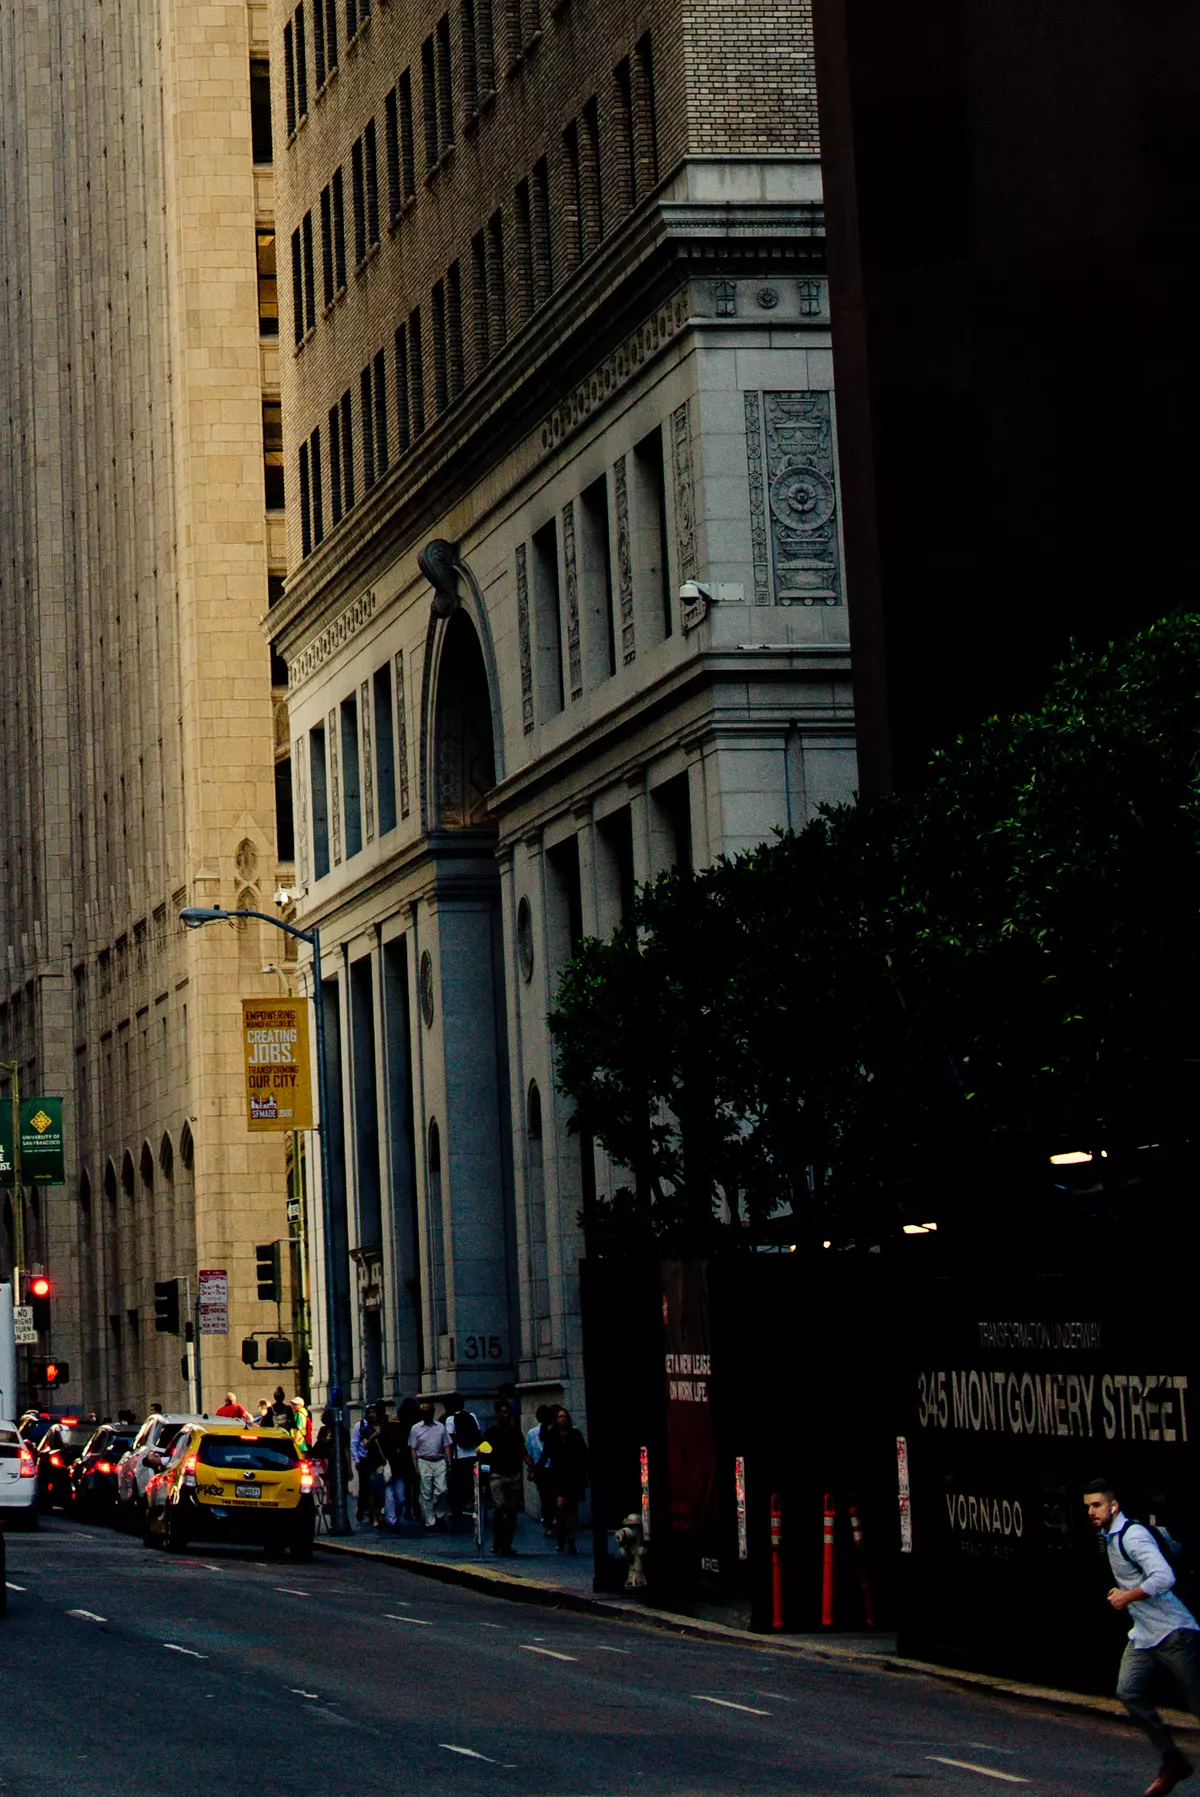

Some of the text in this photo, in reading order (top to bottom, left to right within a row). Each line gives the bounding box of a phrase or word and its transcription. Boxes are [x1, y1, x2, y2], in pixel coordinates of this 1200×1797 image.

[246, 1010, 296, 1020] EMPOWERING
[247, 1029, 297, 1043] CREATING
[248, 1043, 296, 1064] JOBS.
[248, 1065, 299, 1075] TRANSFORMING
[248, 1074, 299, 1089] OUR CITY.
[251, 1109, 277, 1118] SFMADE
[17, 1308, 28, 1318] NO
[978, 1322, 1102, 1349] TRANSFORMATION UNDERWAY
[464, 1335, 503, 1360] 315
[692, 1354, 711, 1375] LEASE
[918, 1370, 1188, 1442] 345 MONTGOMERY STREET
[946, 1493, 1023, 1537] VORNADO
